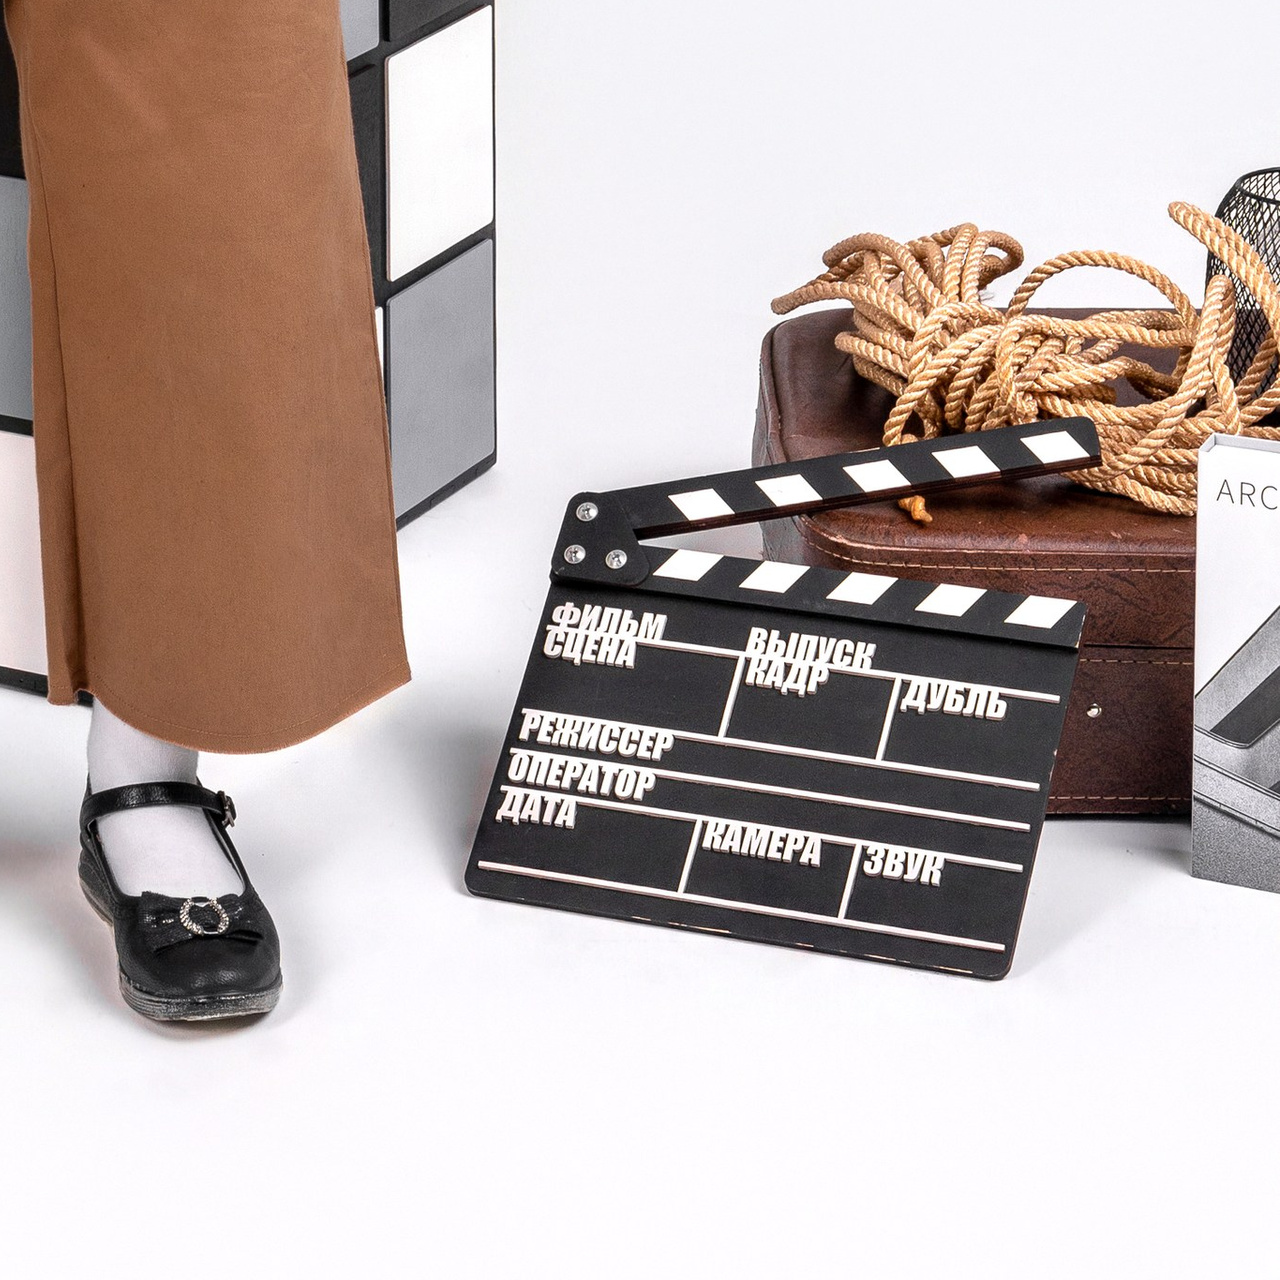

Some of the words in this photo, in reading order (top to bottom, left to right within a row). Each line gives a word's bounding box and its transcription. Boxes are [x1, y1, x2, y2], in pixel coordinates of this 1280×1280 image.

[551, 602, 668, 641] ФИЛЬМ
[543, 627, 637, 669] СЦЕНА
[745, 627, 877, 670] ВЫПУСК
[745, 656, 829, 697] КАДР
[900, 678, 1007, 720] ДУБЛЬ
[519, 710, 674, 761] РЕЖИССЕР
[507, 751, 656, 801] ОПЕРАТОР
[495, 790, 577, 829] ДАТА
[701, 820, 822, 868] КАМЕРА
[863, 844, 944, 887] ЗВУК
